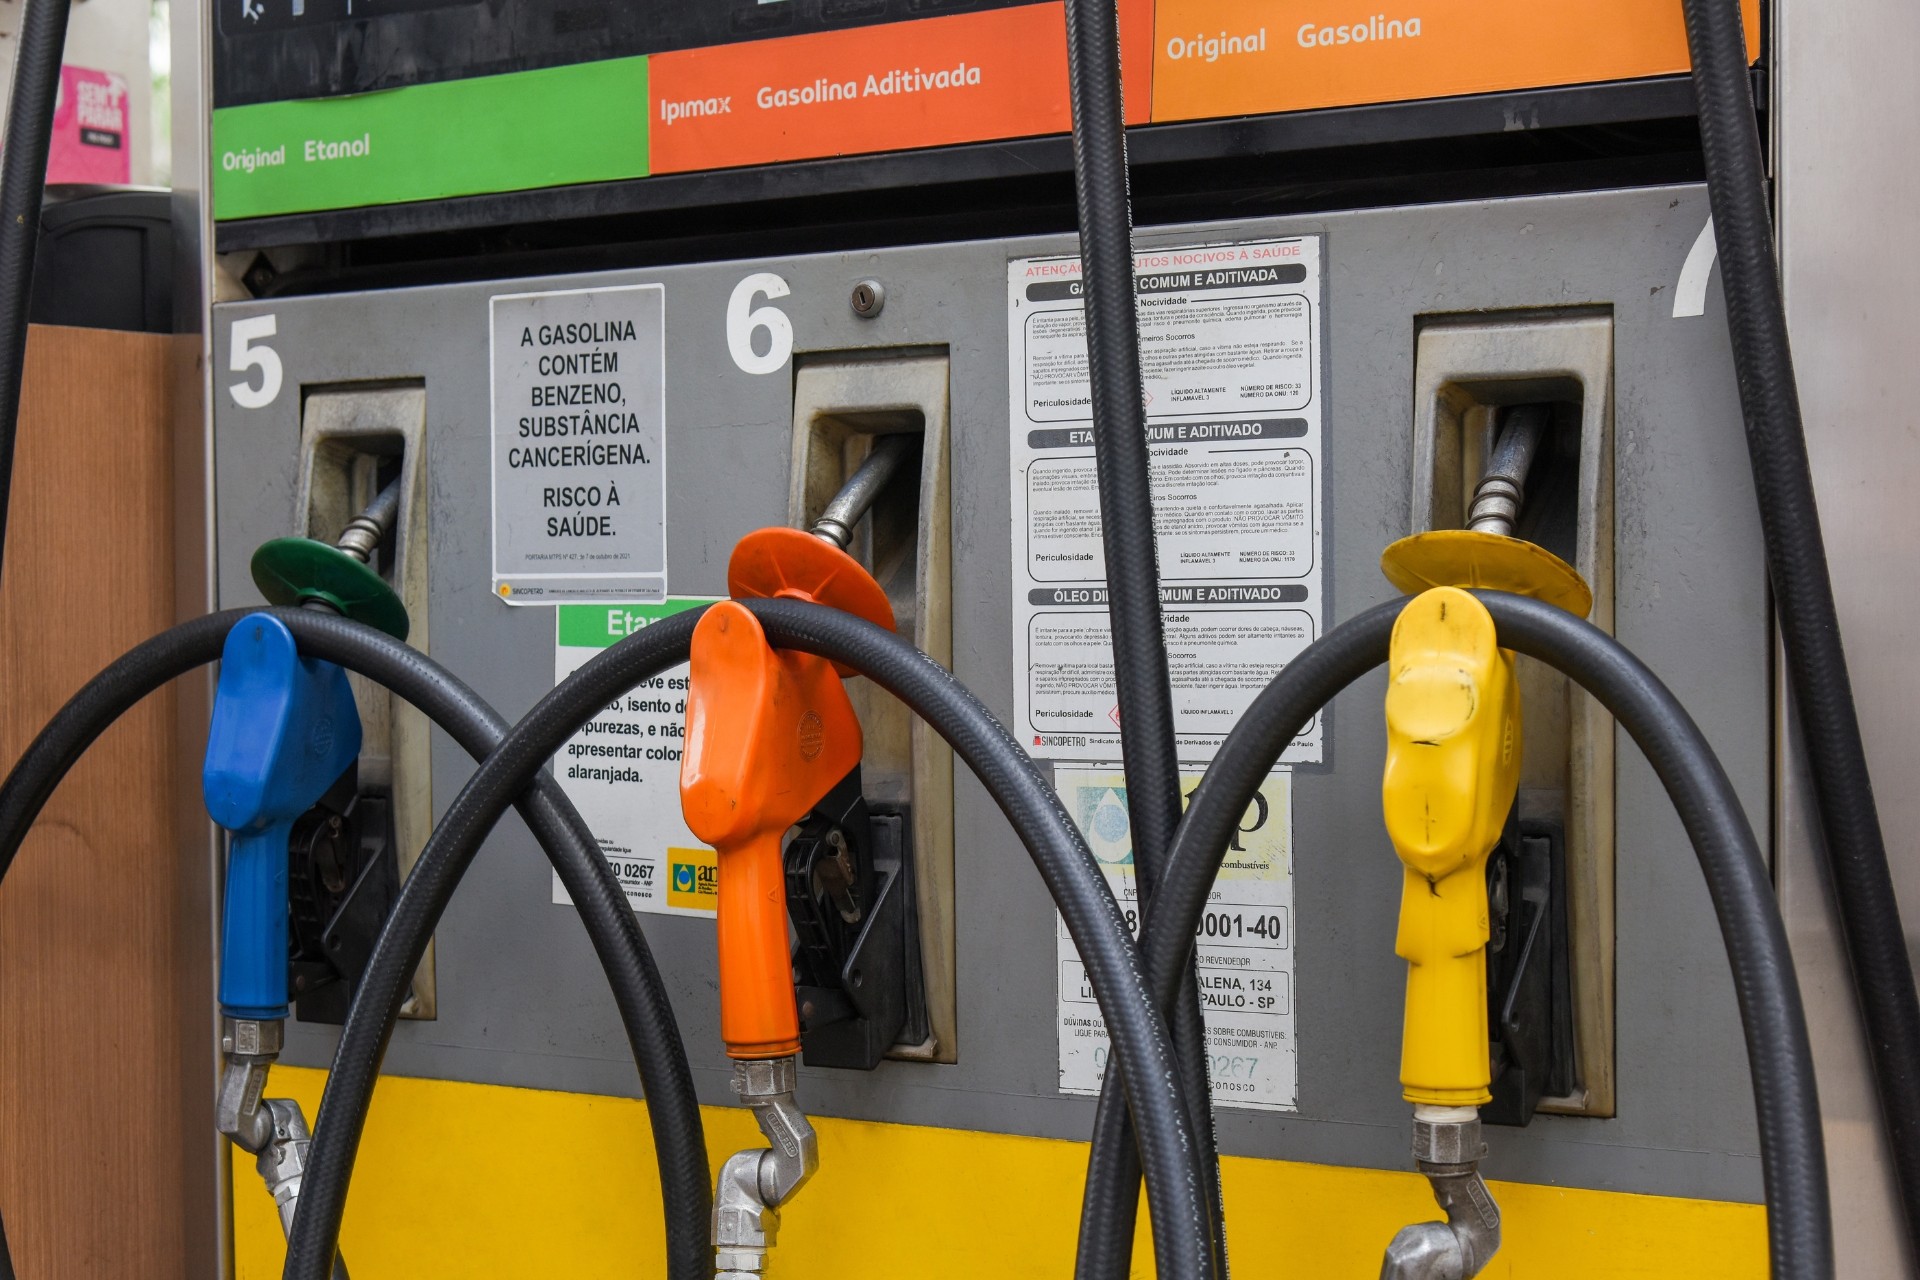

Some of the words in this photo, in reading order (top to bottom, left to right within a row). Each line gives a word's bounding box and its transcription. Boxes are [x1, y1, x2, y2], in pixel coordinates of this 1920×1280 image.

[1167, 29, 1266, 63] Original
[1297, 13, 1422, 48] Gasolina
[757, 79, 857, 109] Gasolina
[863, 63, 981, 97] Aditivada
[222, 144, 286, 174] Original
[304, 133, 371, 163] Etanol
[1173, 251, 1235, 265] NOCIVOS
[1239, 247, 1250, 260] À
[1253, 245, 1301, 259] SAÚDE
[1140, 274, 1191, 290] COMUM
[1195, 273, 1203, 286] E
[1206, 268, 1278, 285] ADITIVADA
[1140, 297, 1187, 307] Nocividade
[726, 272, 794, 375] 6
[521, 327, 534, 347] A
[538, 320, 637, 346] GASOLINA
[1166, 333, 1196, 342] Socorros
[228, 314, 284, 409] 5
[539, 347, 618, 376] CONTÉM
[531, 382, 626, 407] BENZENO,
[1033, 397, 1092, 408] Periculosidade
[519, 409, 640, 437] SUBSTÂNCIA
[1178, 426, 1187, 439] E
[1190, 423, 1263, 439] ADITIVADO
[1070, 431, 1094, 443] ETA
[508, 440, 651, 468] CANCERÍGENA.
[1149, 448, 1189, 457] ocividade
[543, 486, 601, 508] RISCO
[606, 480, 621, 506] À
[1167, 493, 1197, 501] Socorros
[547, 511, 617, 537] SAÚDE.
[1035, 553, 1094, 562] Periculosidade
[1054, 588, 1090, 603] ÓLEO
[1196, 588, 1205, 600] E
[1208, 587, 1281, 601] ADITIVADO
[608, 609, 662, 636] Eta
[640, 677, 664, 689] eve
[668, 676, 690, 690] est
[627, 697, 671, 713] isento
[1035, 709, 1094, 719] Periculosidade
[582, 722, 644, 738] purezas,
[648, 725, 656, 736] e
[1041, 736, 1086, 747] SINCOPETRO
[1184, 738, 1212, 746] Derivados
[568, 743, 643, 759] apresentar
[646, 745, 683, 761] color
[568, 764, 643, 784] alaranjada.
[624, 863, 655, 879] 0267
[1221, 860, 1270, 870] combustíveis
[1196, 913, 1281, 939] 0001-40
[1200, 976, 1245, 992] ALENA,
[1250, 979, 1272, 992] 134
[1258, 996, 1275, 1009] SP
[1074, 1029, 1092, 1037] LIGUE
[1214, 1038, 1257, 1048] CONSUMIDOR
[1213, 1027, 1235, 1036] SOBRE
[1236, 1028, 1287, 1040] COMBUSTÍVEIS:
